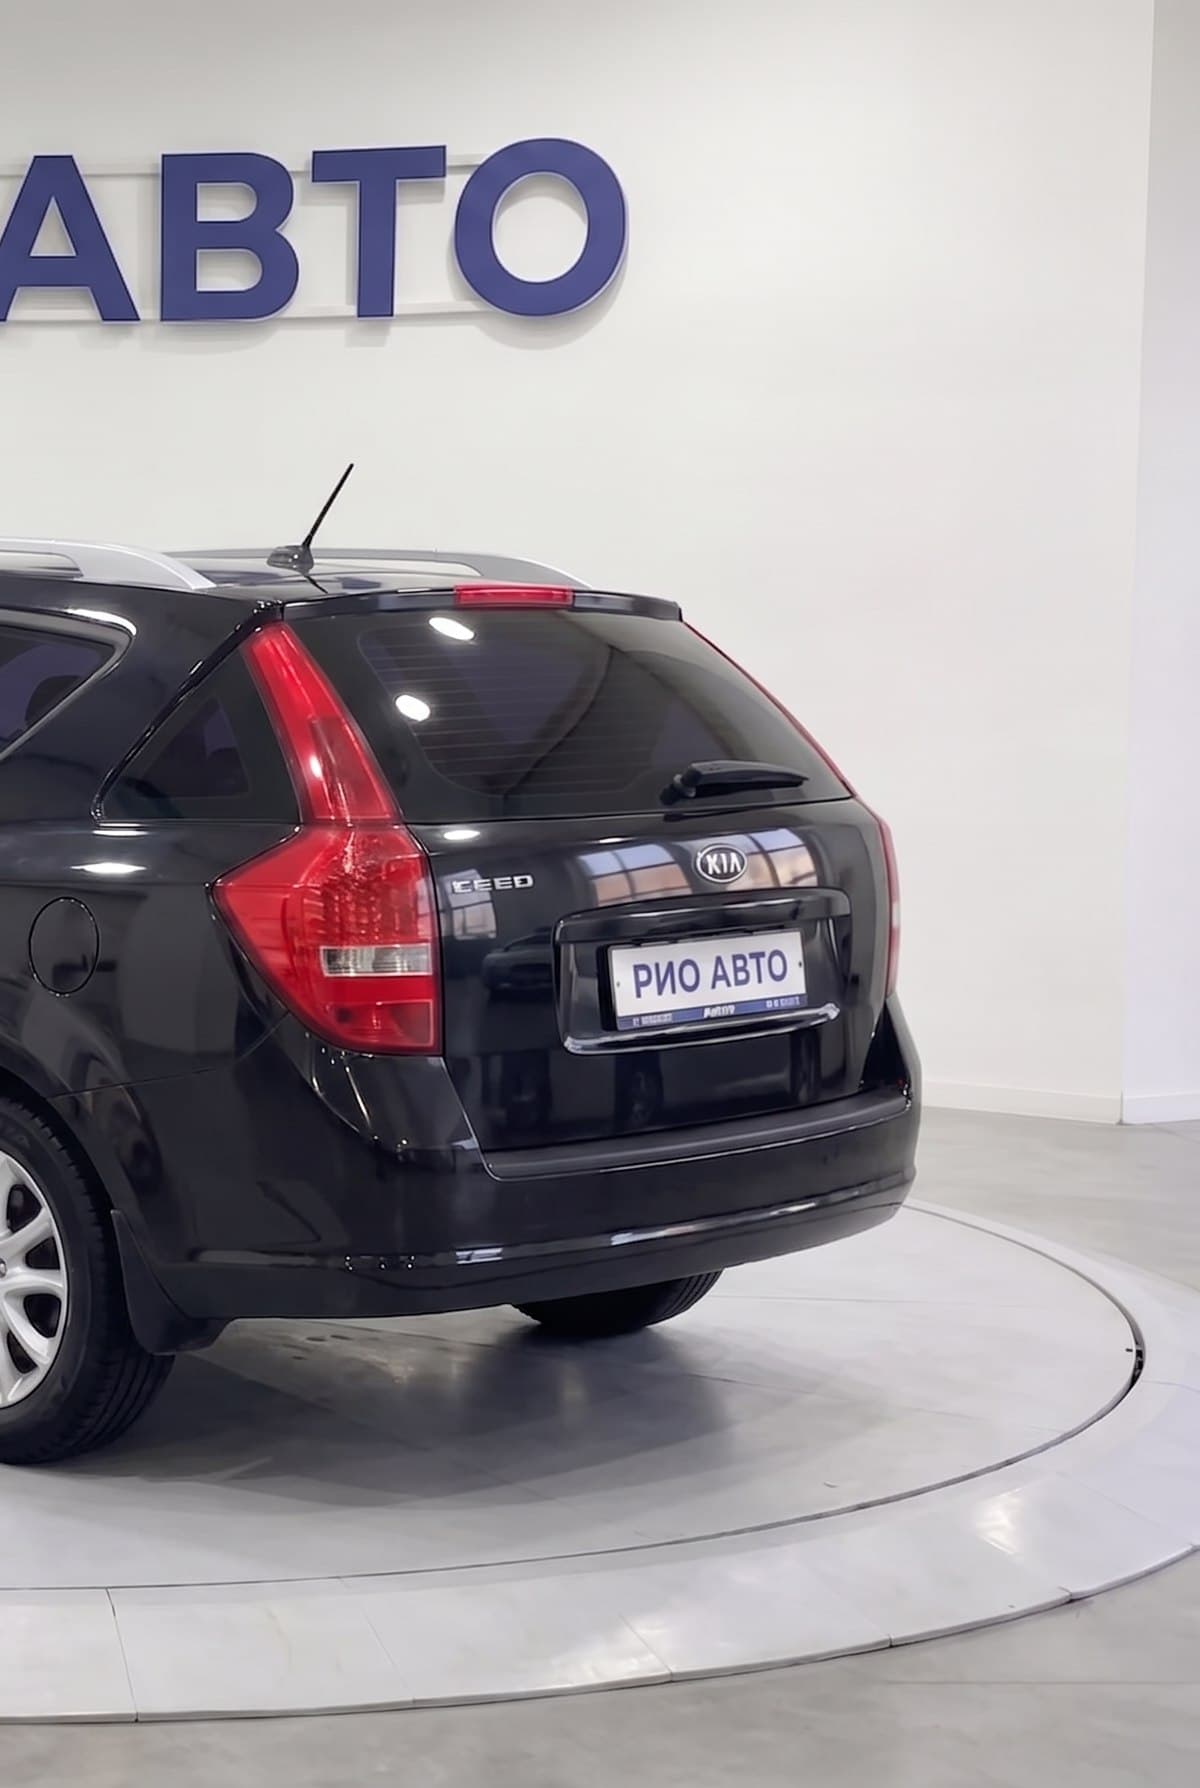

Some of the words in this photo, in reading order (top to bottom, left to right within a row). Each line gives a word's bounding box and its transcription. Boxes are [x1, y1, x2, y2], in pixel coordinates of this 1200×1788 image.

[707, 853, 742, 876] KIA
[632, 958, 701, 999] РИО
[711, 949, 788, 990] АВТО
